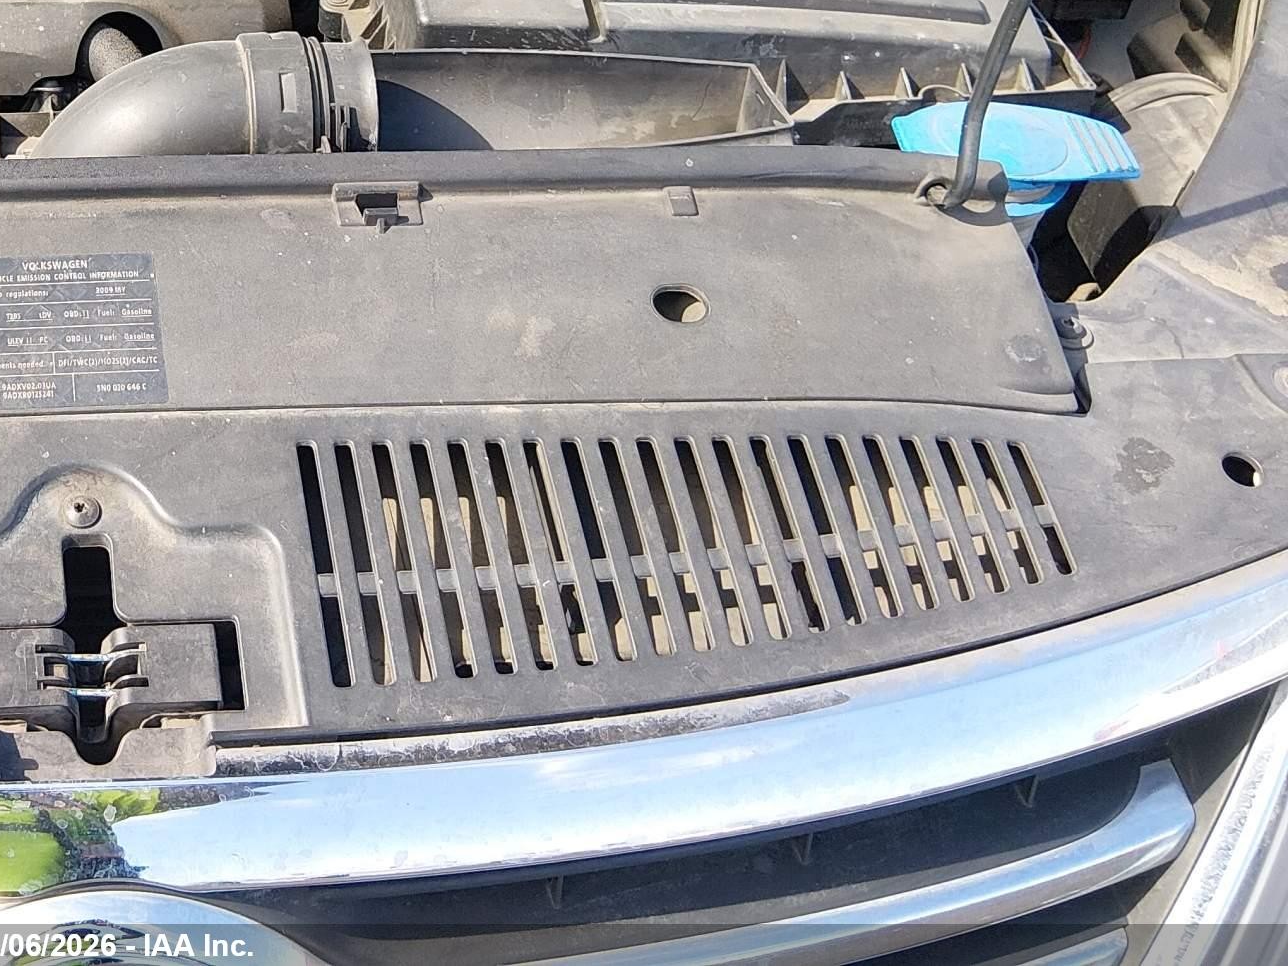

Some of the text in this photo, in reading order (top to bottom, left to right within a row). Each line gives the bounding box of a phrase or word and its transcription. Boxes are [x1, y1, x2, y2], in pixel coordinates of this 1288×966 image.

[22, 260, 88, 271] VOLKSWAGEN
[16, 274, 50, 282] EMISSION
[54, 272, 86, 280] CONTROL
[90, 270, 138, 279] INFORMATION
[6, 290, 48, 298] regulations:
[124, 332, 154, 340] Gasoline
